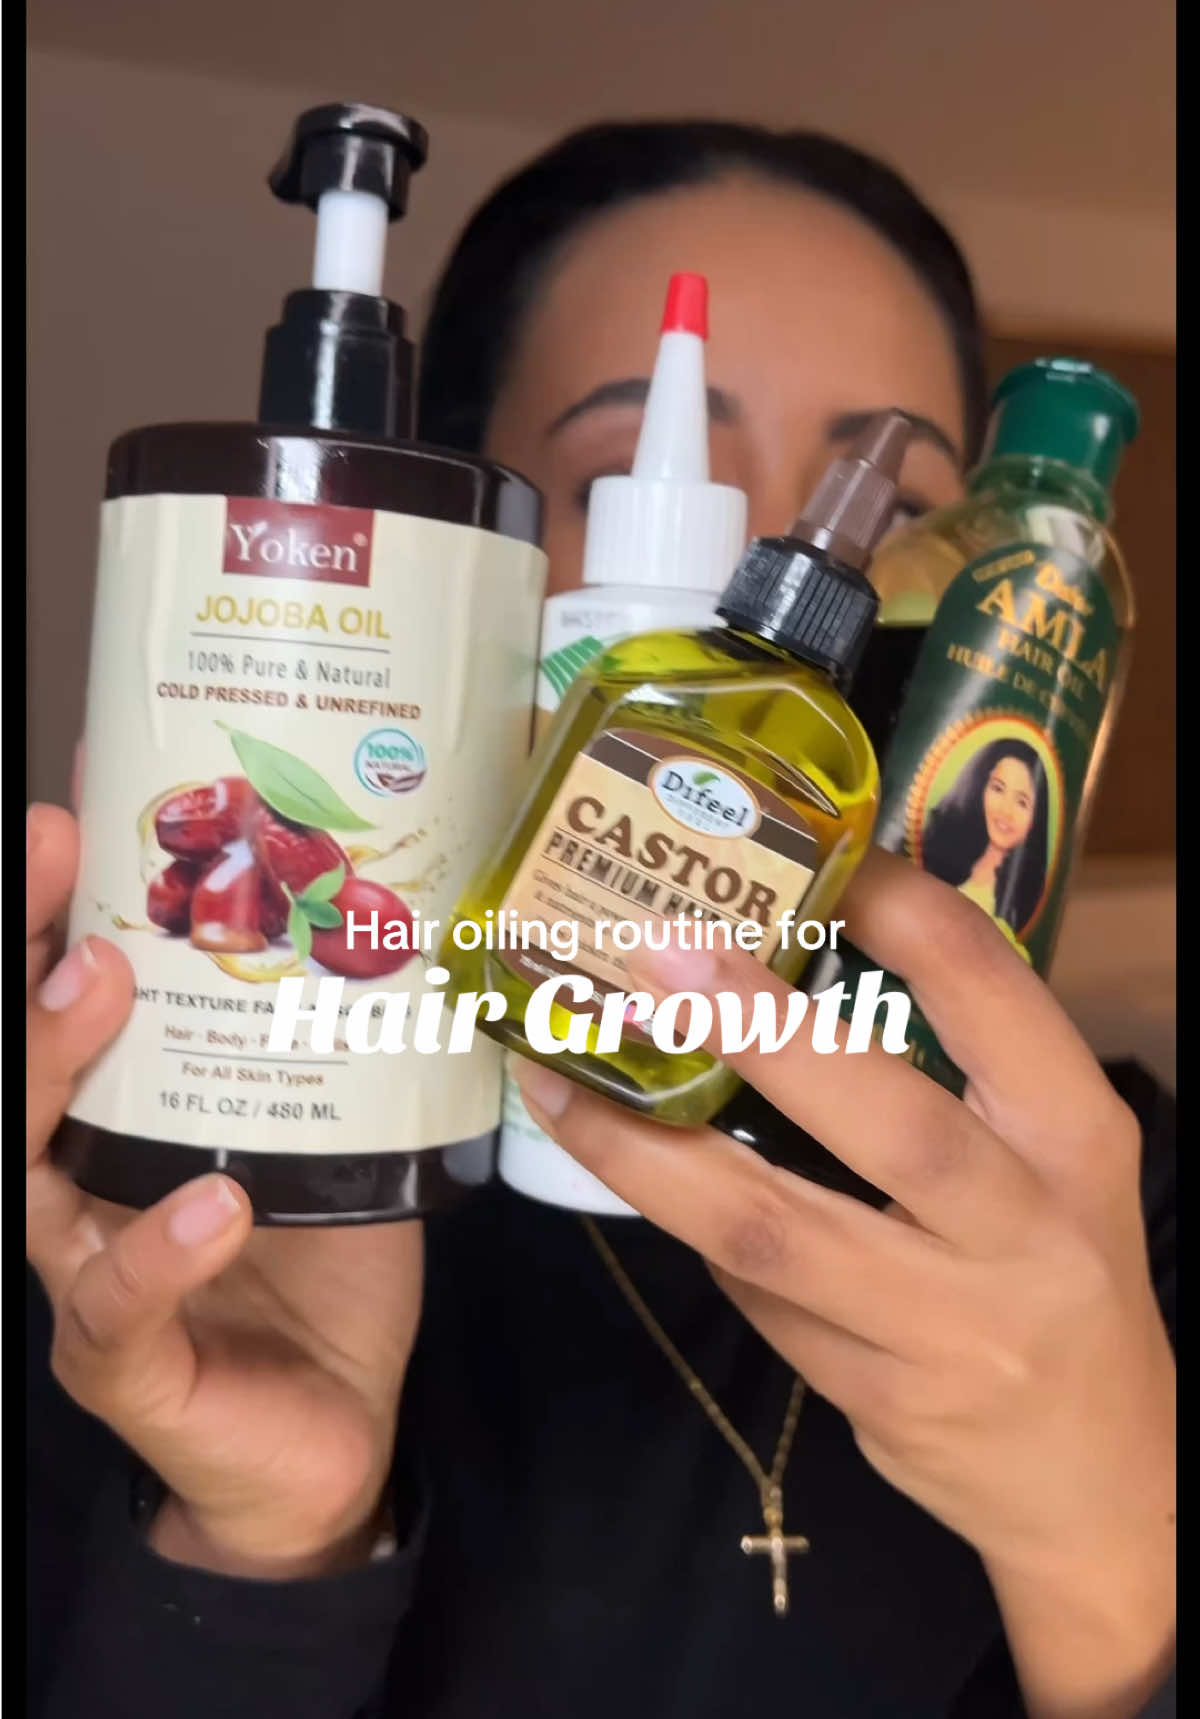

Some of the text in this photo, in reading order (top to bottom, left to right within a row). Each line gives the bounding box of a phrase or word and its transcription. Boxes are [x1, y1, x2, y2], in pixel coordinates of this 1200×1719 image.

[229, 520, 358, 573] Yoken
[195, 594, 391, 640] JOJOBA OIL
[187, 650, 392, 689] 100% Pure & Natural
[156, 681, 423, 721] COLD PRESSED & UNREFINED
[367, 742, 414, 761] 100%
[661, 770, 749, 827] Difeel
[543, 832, 661, 908] PREMIUM
[566, 796, 779, 928] CASTOR
[165, 990, 249, 1014] TEXTURE
[164, 1024, 193, 1041] Hair
[206, 1029, 246, 1049] Body
[181, 1061, 325, 1088] For All Skin Types
[160, 1090, 342, 1122] 16 FL OZ / 480 ML
